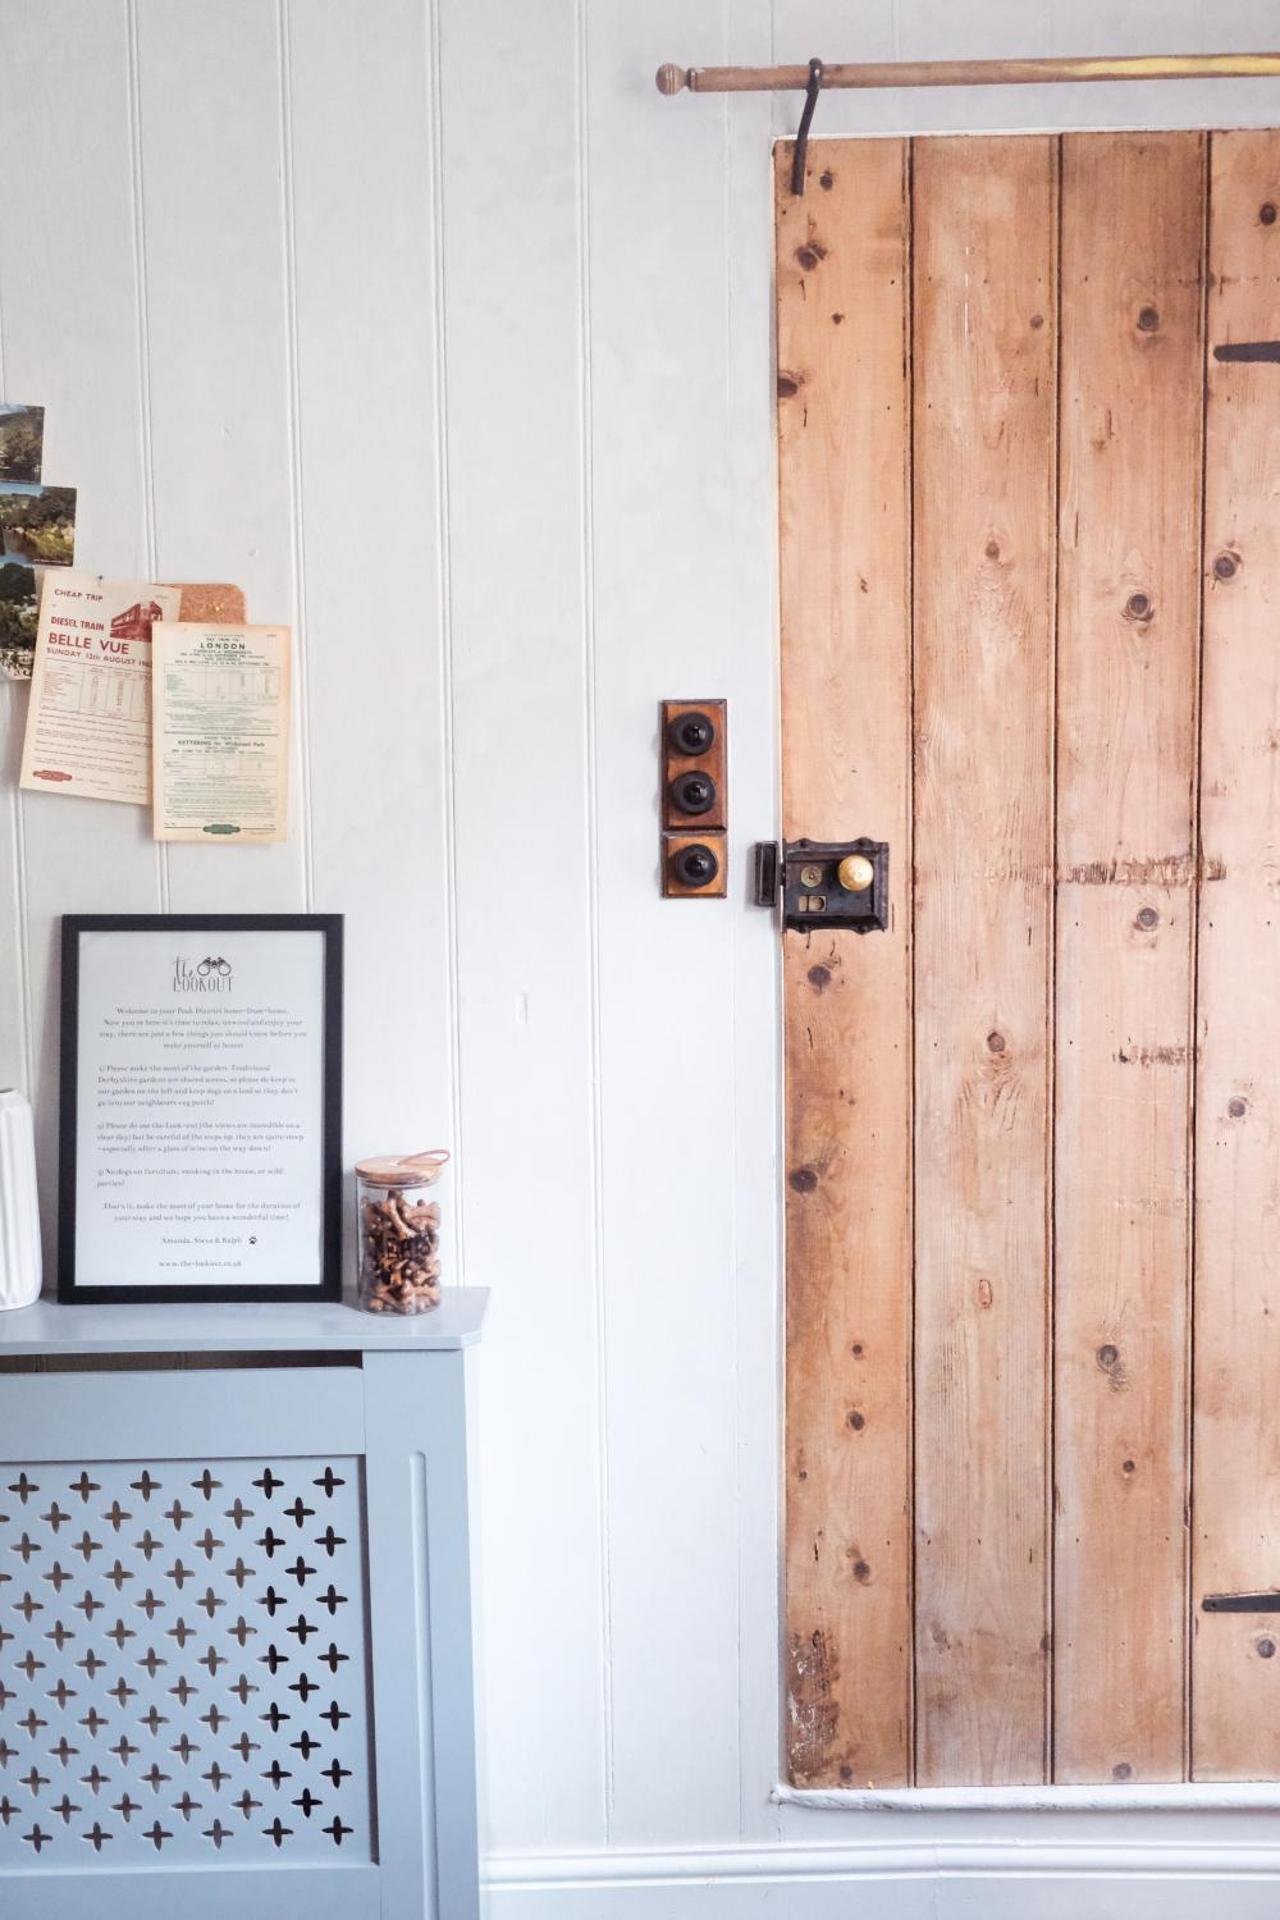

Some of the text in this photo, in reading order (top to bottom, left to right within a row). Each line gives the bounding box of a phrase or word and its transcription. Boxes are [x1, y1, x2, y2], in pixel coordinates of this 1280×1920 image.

[54, 588, 103, 601] CHEAP TRIP
[51, 616, 104, 632] DIESEL TRAIN
[48, 632, 130, 655] BELLE VUE
[200, 641, 246, 650] LONDON
[46, 647, 82, 658] SUNDAY
[103, 655, 136, 665] AUGUST
[173, 976, 232, 993] LOOKOUT
